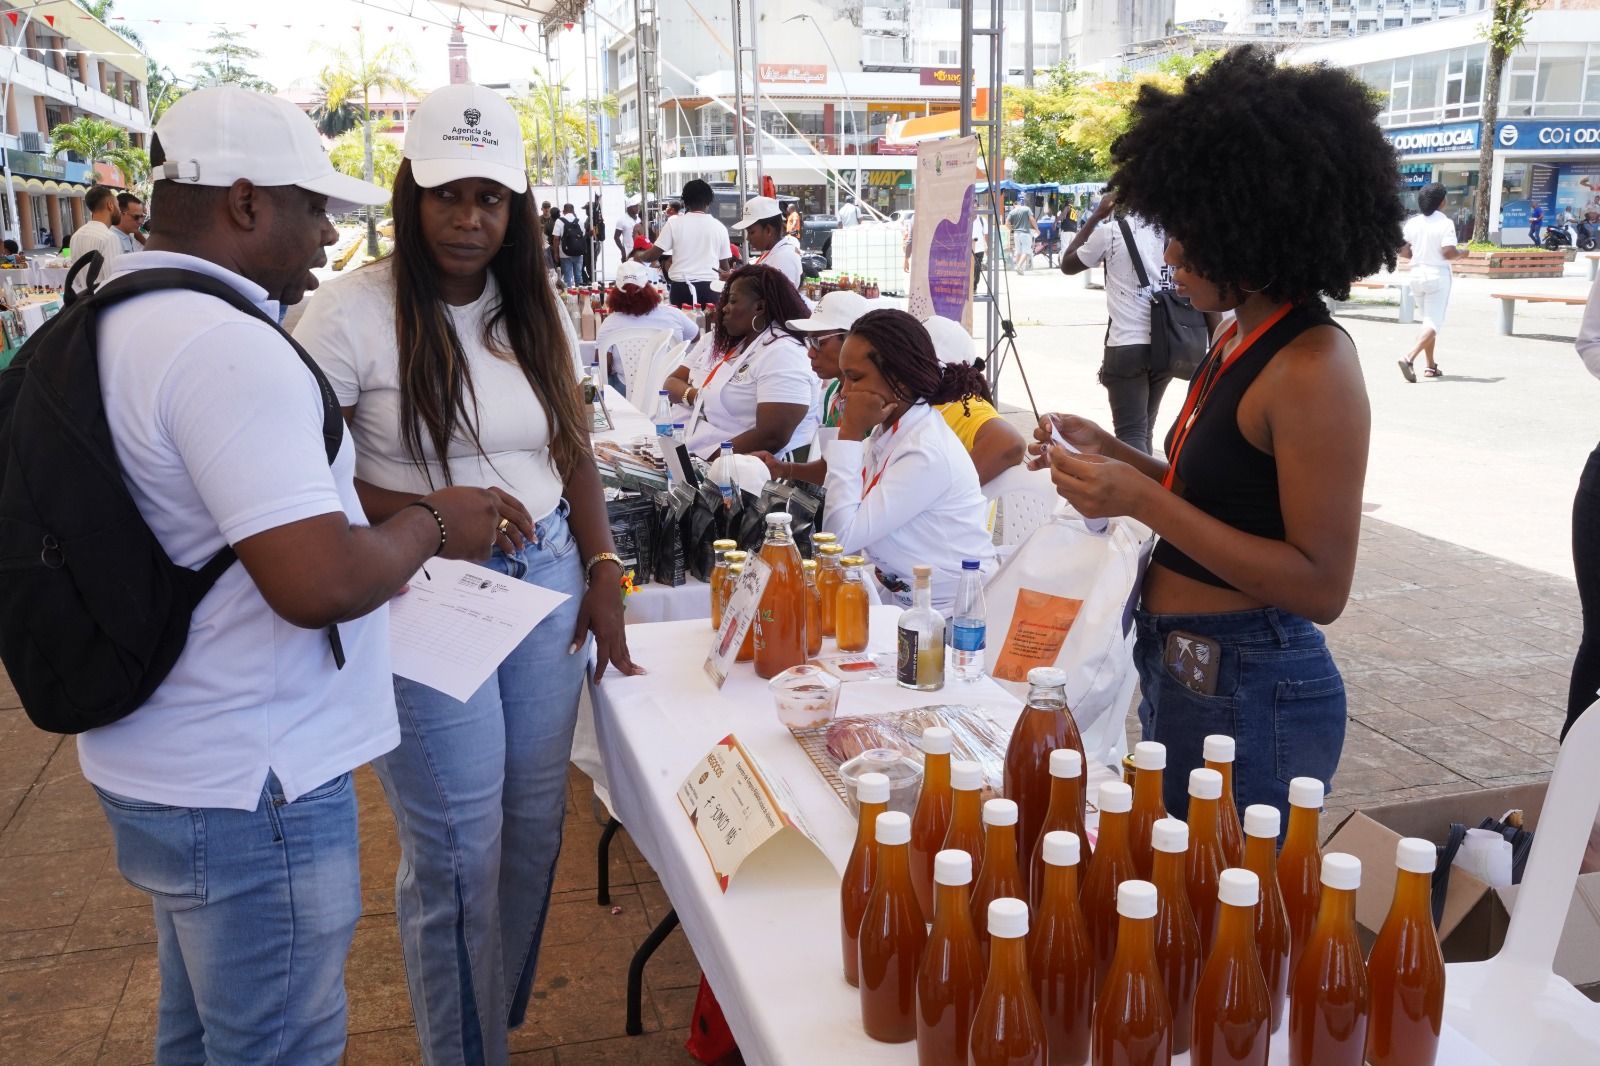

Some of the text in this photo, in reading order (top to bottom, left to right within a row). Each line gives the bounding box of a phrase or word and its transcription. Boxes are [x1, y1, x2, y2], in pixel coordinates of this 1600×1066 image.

[452, 126, 492, 137] Agencia de
[442, 134, 499, 147] Desarrollo Rural
[842, 170, 906, 187] SUBWAY
[710, 803, 730, 832] SOMOS
